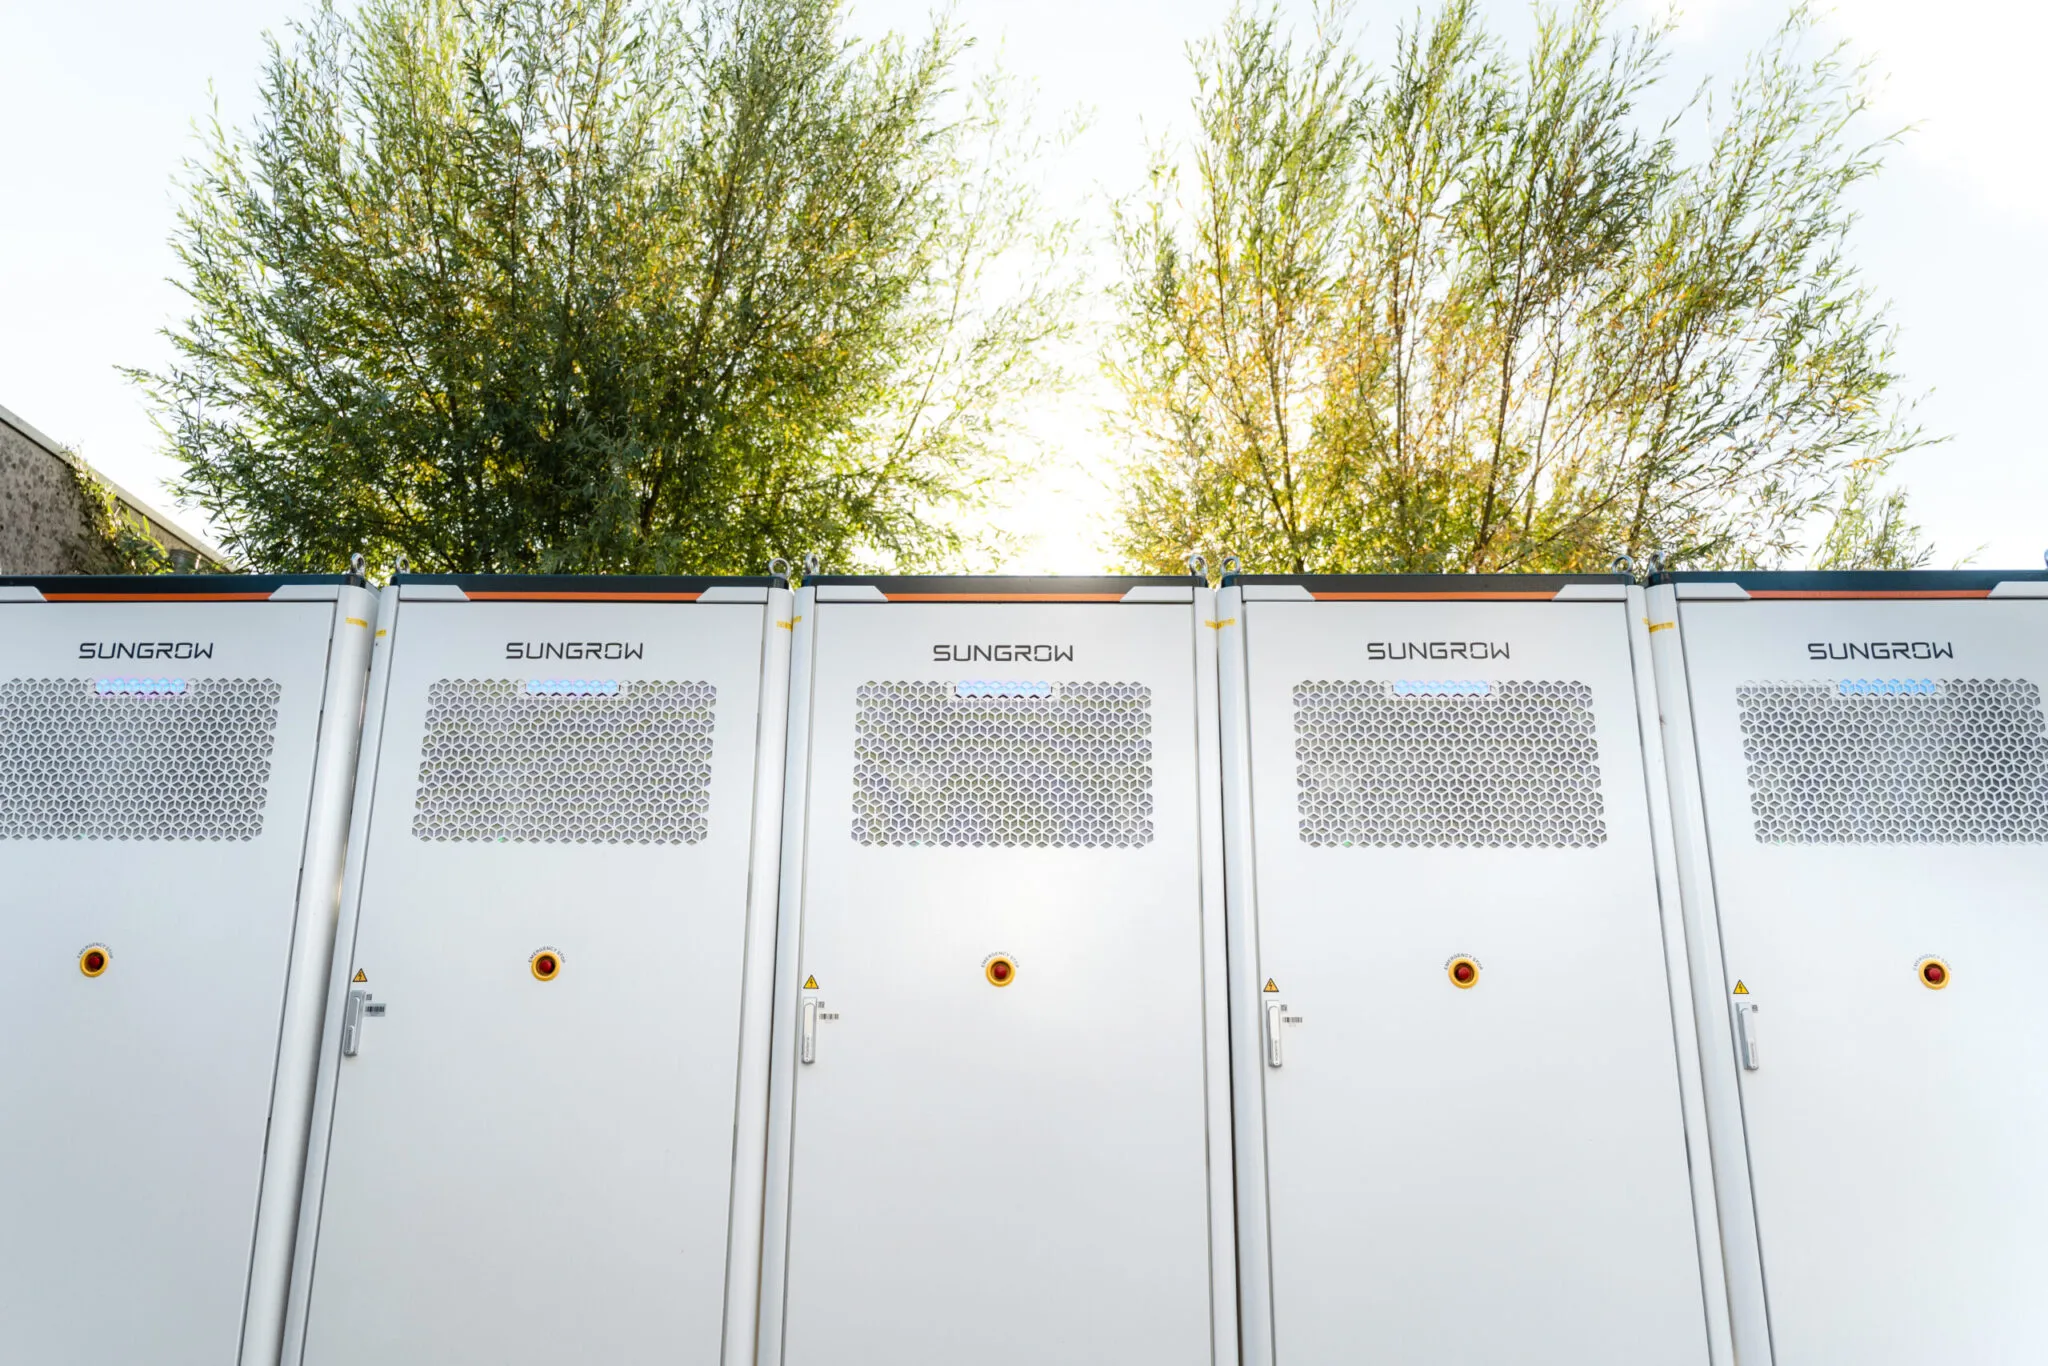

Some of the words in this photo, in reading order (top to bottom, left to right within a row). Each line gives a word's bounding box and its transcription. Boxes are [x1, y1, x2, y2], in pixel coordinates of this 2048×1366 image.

[78, 642, 214, 660] SUNGROW
[505, 642, 644, 660] SUNGROW
[933, 644, 1074, 662] SUNGROW
[1366, 641, 1510, 661] SUNGROW
[1807, 641, 1954, 660] SUNGROW
[528, 945, 557, 963] EMERGENCY
[981, 951, 1010, 968] EMERGENCY
[1444, 953, 1472, 970] EMERGENCY
